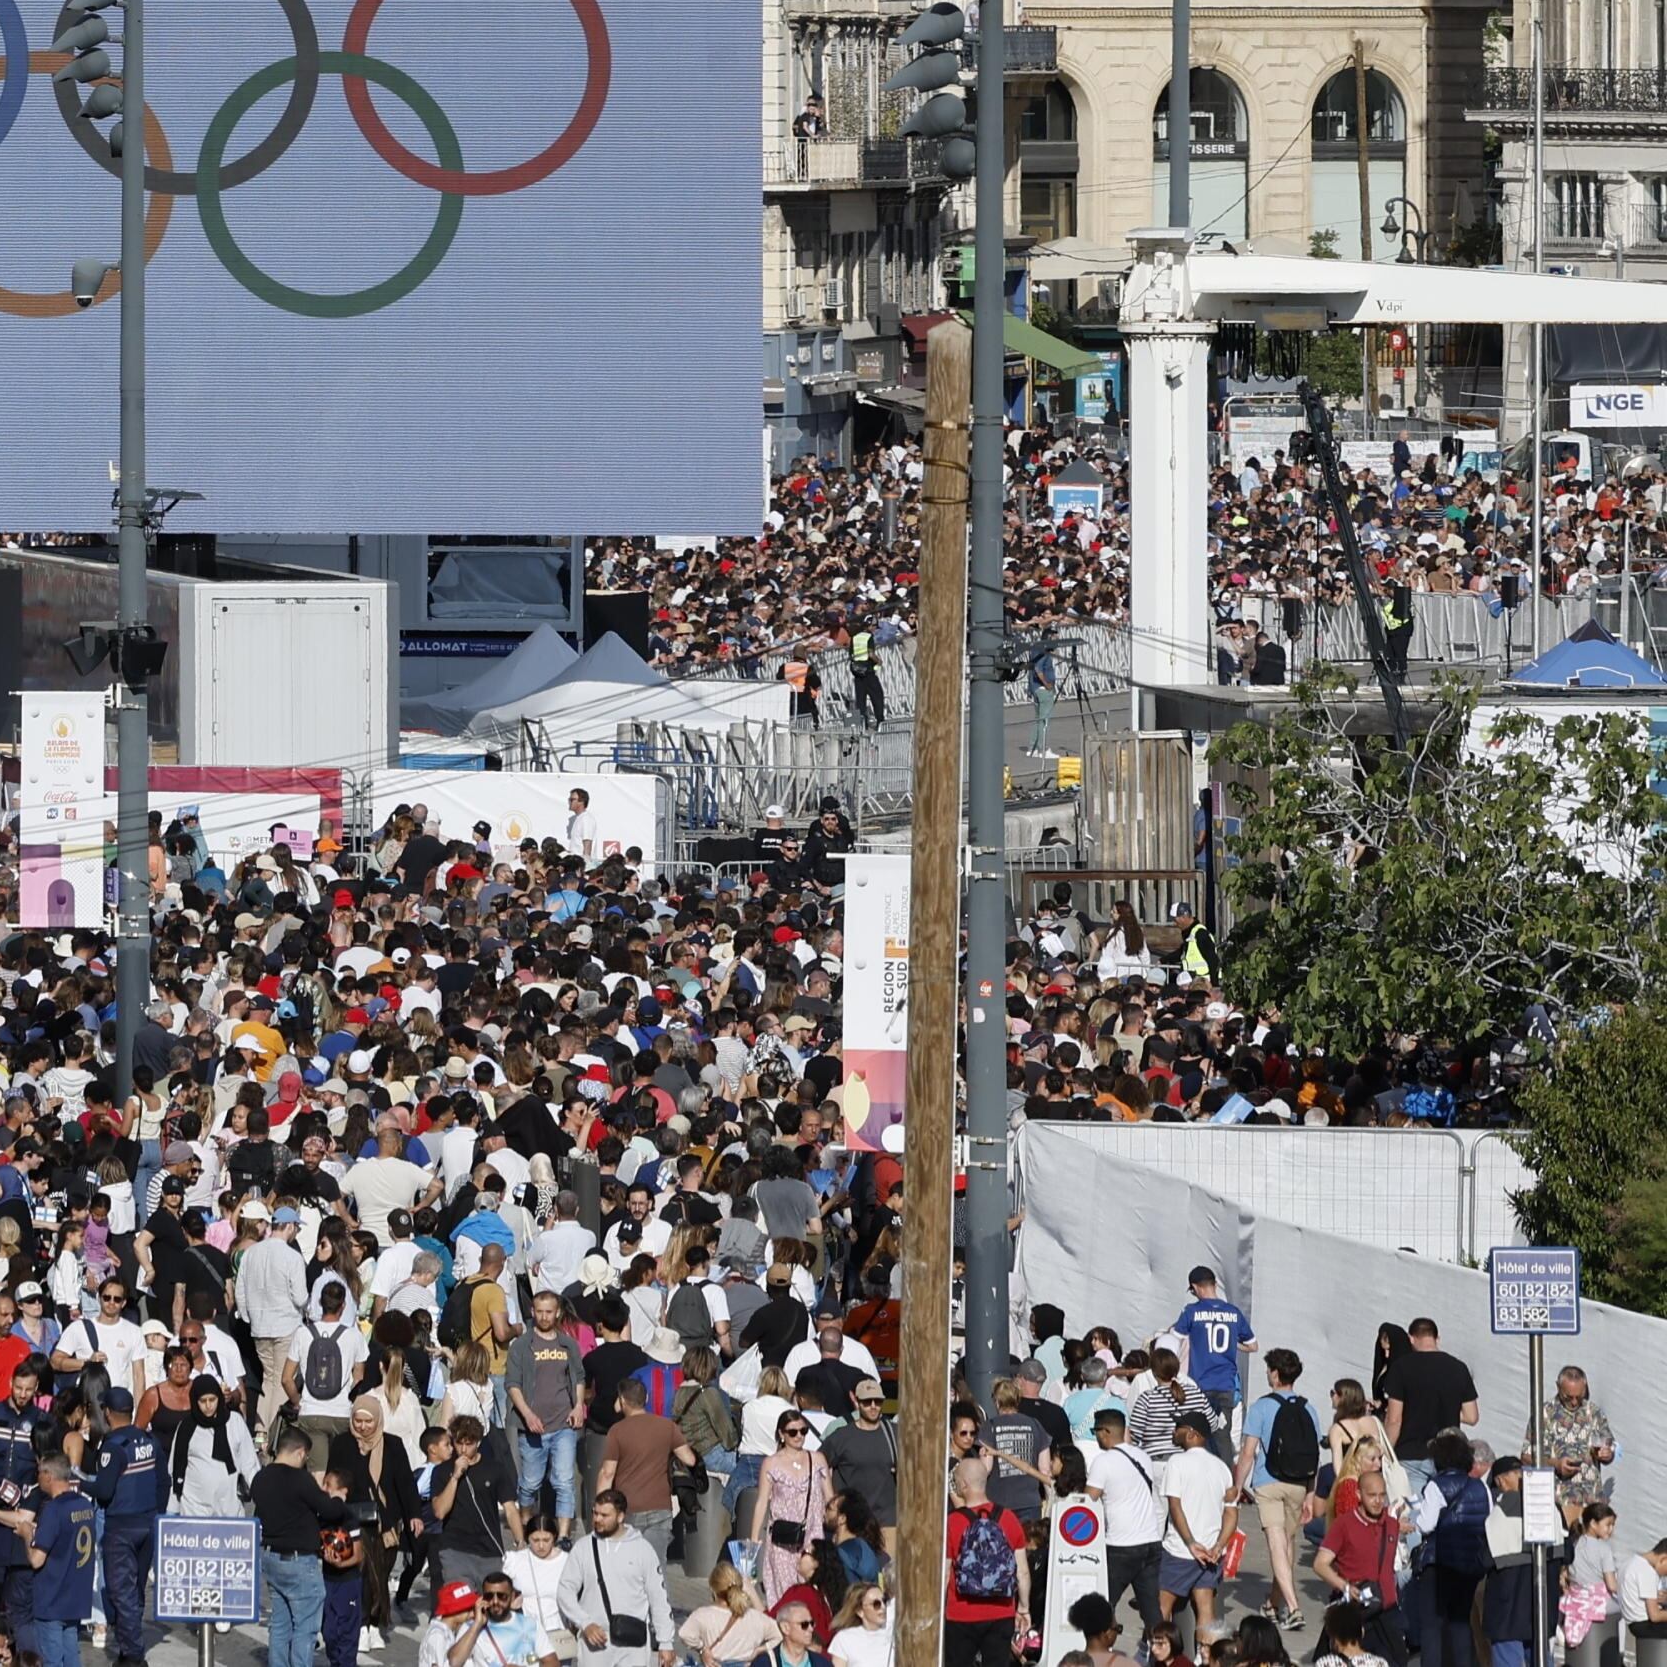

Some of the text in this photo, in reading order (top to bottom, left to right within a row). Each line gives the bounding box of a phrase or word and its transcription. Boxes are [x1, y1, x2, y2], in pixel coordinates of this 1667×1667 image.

[1595, 394, 1644, 411] NGE
[407, 642, 468, 652] ALLOMAT
[896, 961, 908, 990] SUD
[1497, 1261, 1571, 1274] Hôtel de ville
[1498, 1283, 1518, 1297] 60
[1525, 1284, 1544, 1297] 82
[1499, 1307, 1548, 1322] 83 582
[1204, 1322, 1230, 1354] 10
[533, 1348, 568, 1361] adidas
[75, 1525, 92, 1569] 9
[163, 1533, 251, 1549] Hôtel de ville
[163, 1559, 187, 1577] 60
[195, 1560, 218, 1578] 82
[163, 1588, 221, 1607] 83 582
